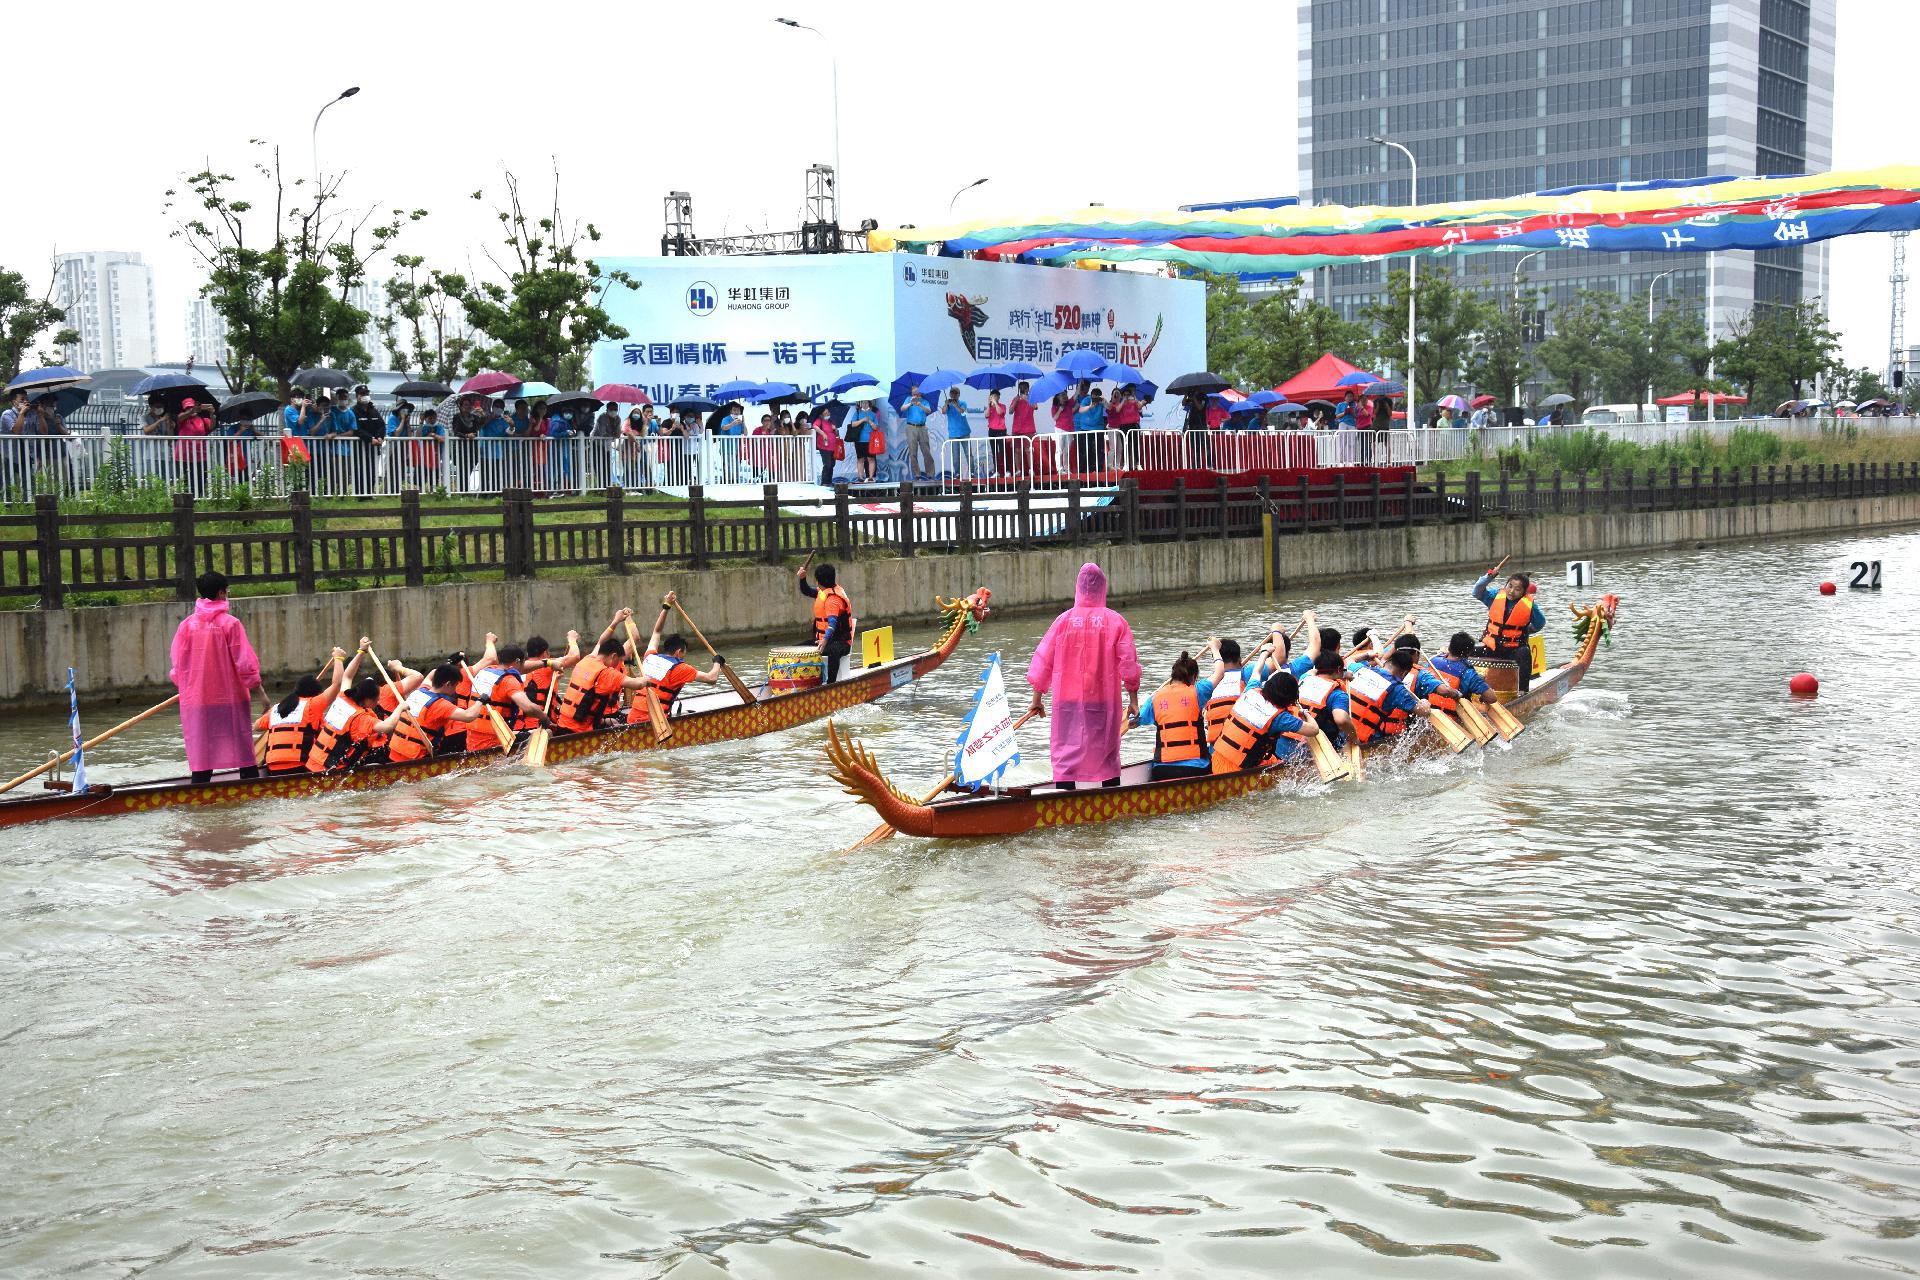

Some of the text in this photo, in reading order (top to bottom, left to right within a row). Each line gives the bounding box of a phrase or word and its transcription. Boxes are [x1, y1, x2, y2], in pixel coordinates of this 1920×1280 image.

[921, 268, 948, 279] 华虹集团
[727, 287, 790, 301] 华虹集团
[727, 303, 762, 311] HUAHONG
[622, 341, 856, 365] 家国情怀 一诺千金
[1571, 562, 1582, 586] 1
[1850, 561, 1868, 588] 2
[874, 634, 881, 657] 1
[1531, 645, 1539, 669] 2
